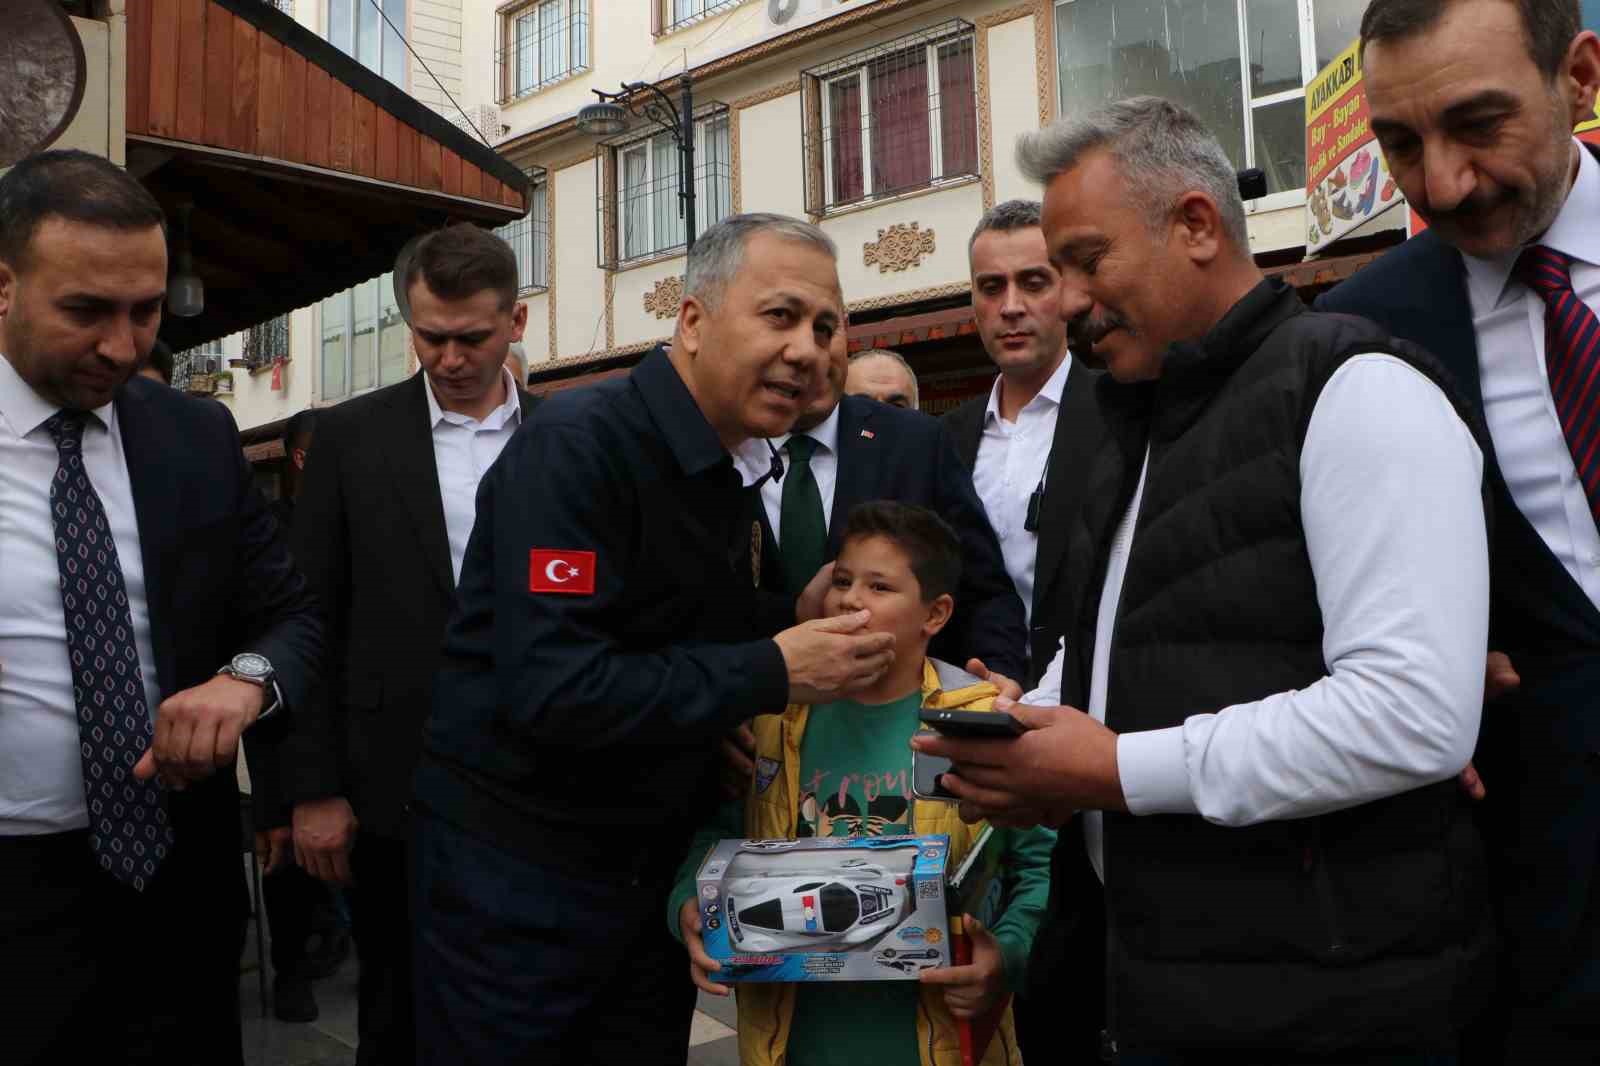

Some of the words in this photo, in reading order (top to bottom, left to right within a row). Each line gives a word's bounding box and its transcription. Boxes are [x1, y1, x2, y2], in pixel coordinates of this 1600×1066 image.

[1311, 53, 1355, 112] AYAKKABI
[1311, 125, 1327, 147] Bay
[1333, 94, 1360, 129] Bayan
